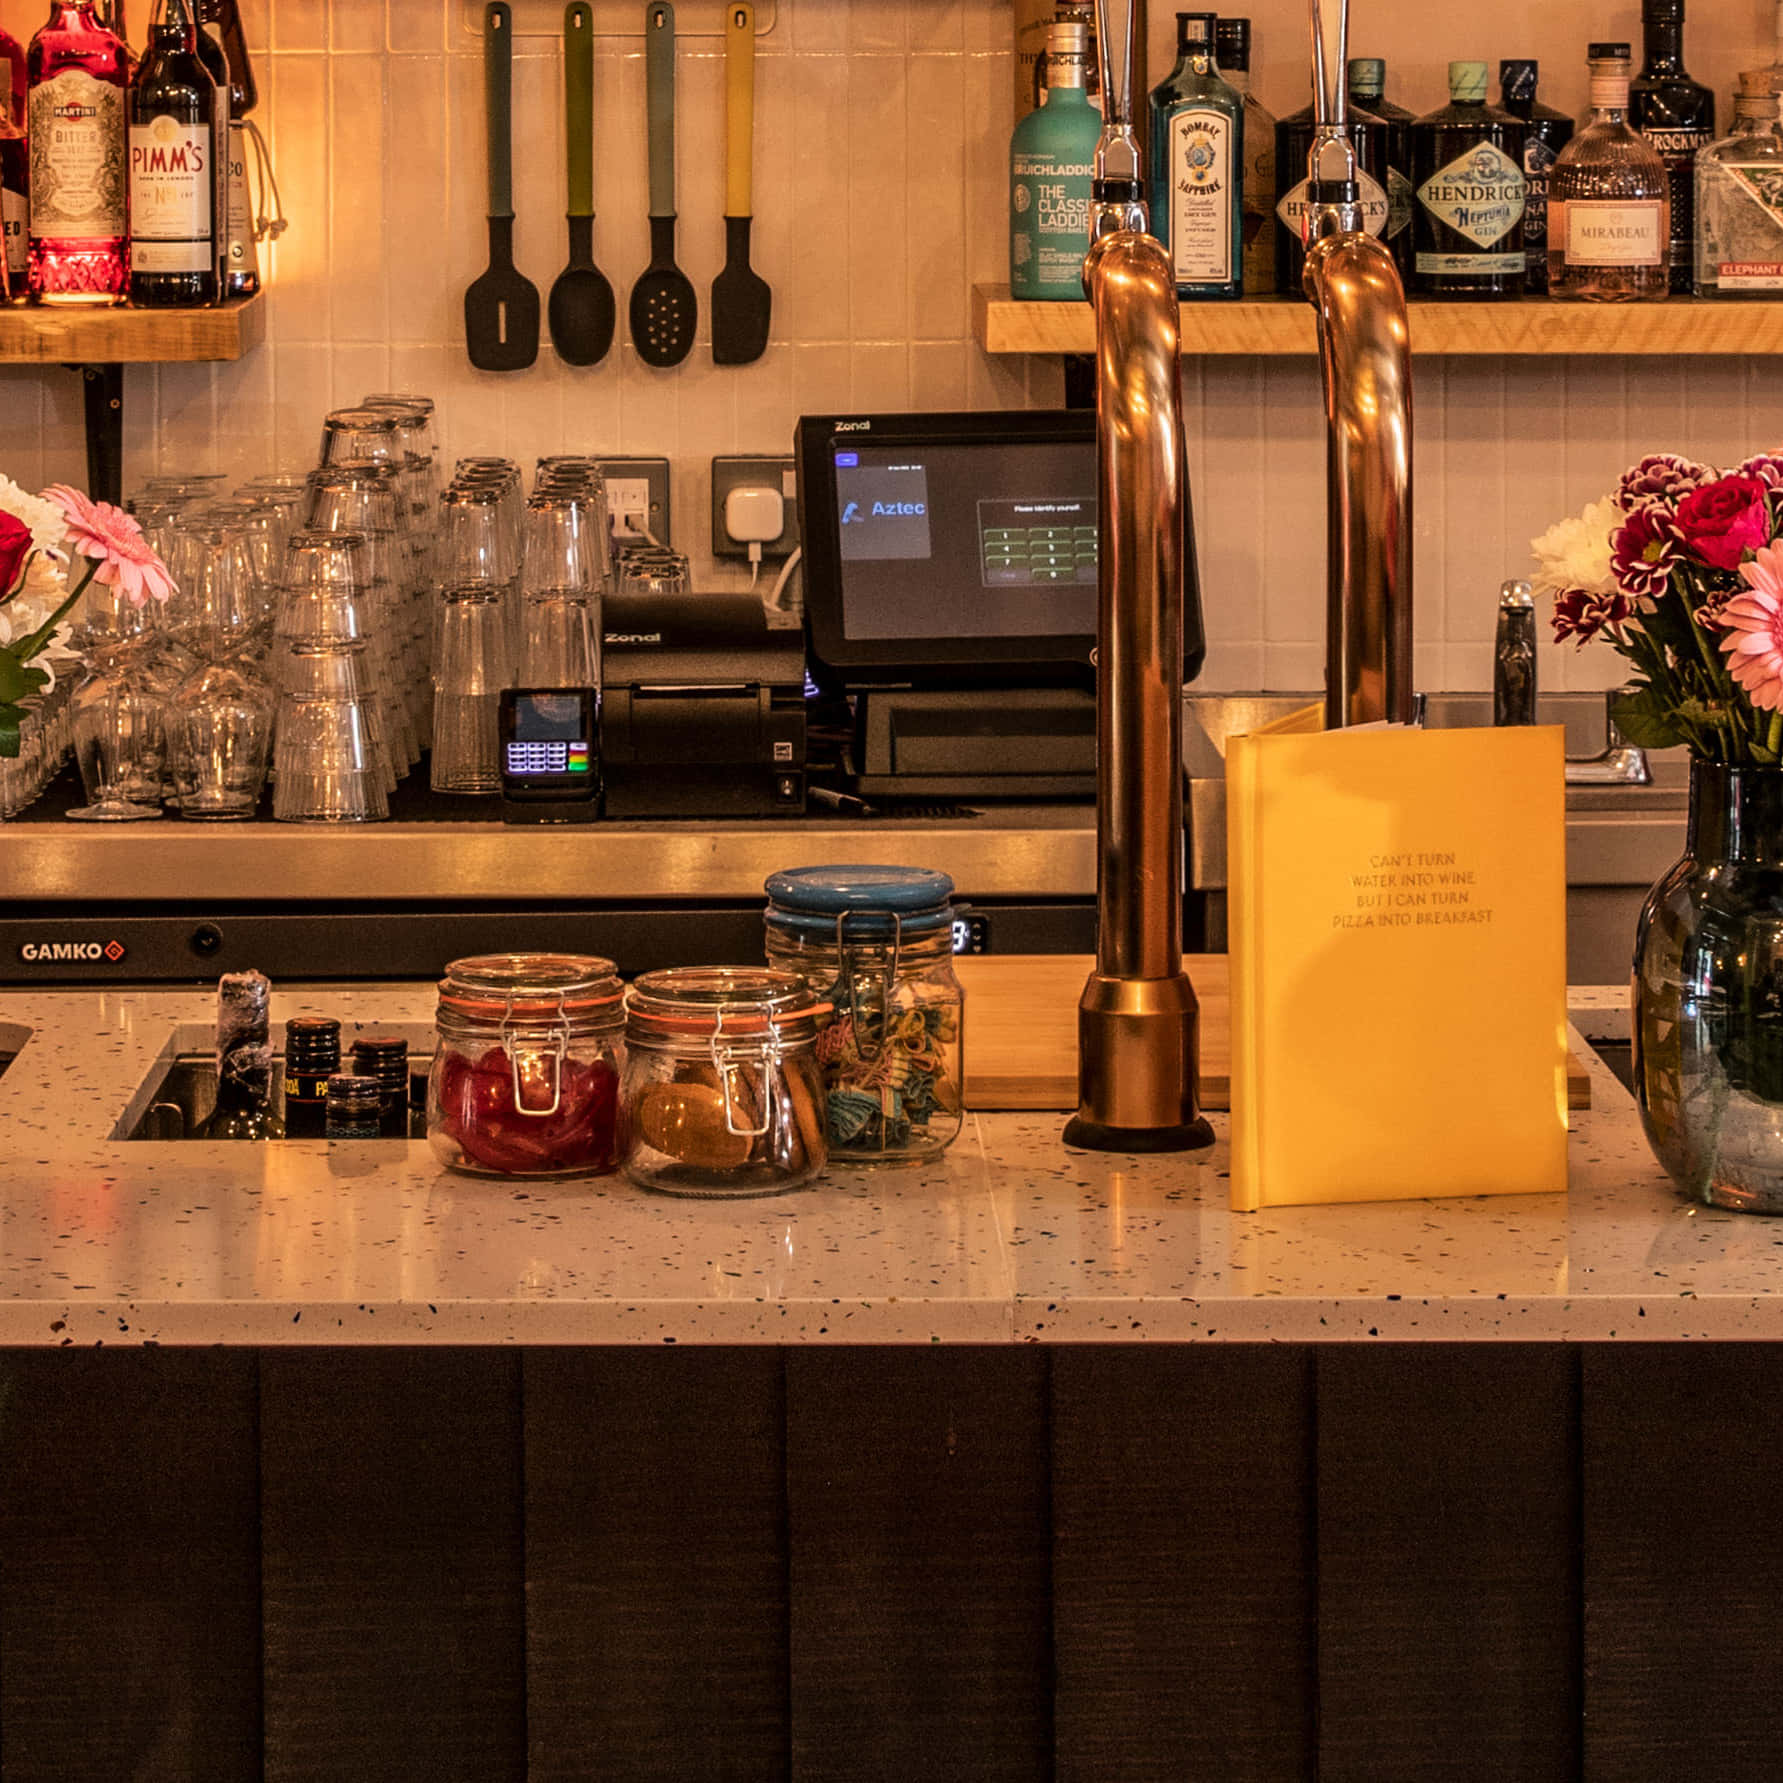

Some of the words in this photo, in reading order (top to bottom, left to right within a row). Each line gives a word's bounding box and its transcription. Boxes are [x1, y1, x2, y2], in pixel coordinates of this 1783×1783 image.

[54, 106, 96, 117] MARTINI
[55, 130, 97, 143] BITTER
[1179, 121, 1222, 140] BOMBAY
[132, 141, 204, 173] PIMM'S
[1038, 184, 1066, 199] THE
[1177, 178, 1223, 196] SAPPHIRE
[1038, 198, 1091, 213] CLASSI
[1039, 213, 1089, 227] LADDIE
[1474, 226, 1498, 236] GIN
[1581, 226, 1650, 239] MIRABEAU
[1721, 265, 1778, 275] ELEPHANT
[835, 420, 871, 432] Zonal
[872, 501, 926, 516] Aztec
[604, 632, 661, 643] Zonal
[1369, 854, 1413, 868] CAN'T
[1416, 852, 1456, 867] TURN
[1352, 873, 1397, 888] WATER
[1400, 872, 1434, 888] INTO
[1438, 871, 1476, 885] WINE
[1356, 894, 1383, 908] BUT
[1395, 893, 1427, 907] CAN
[1430, 891, 1470, 905] TURN
[1332, 914, 1375, 929] PIZZA
[1378, 913, 1412, 927] INTO
[1415, 909, 1494, 926] BREAKFAST
[21, 943, 102, 960] GAMKO
